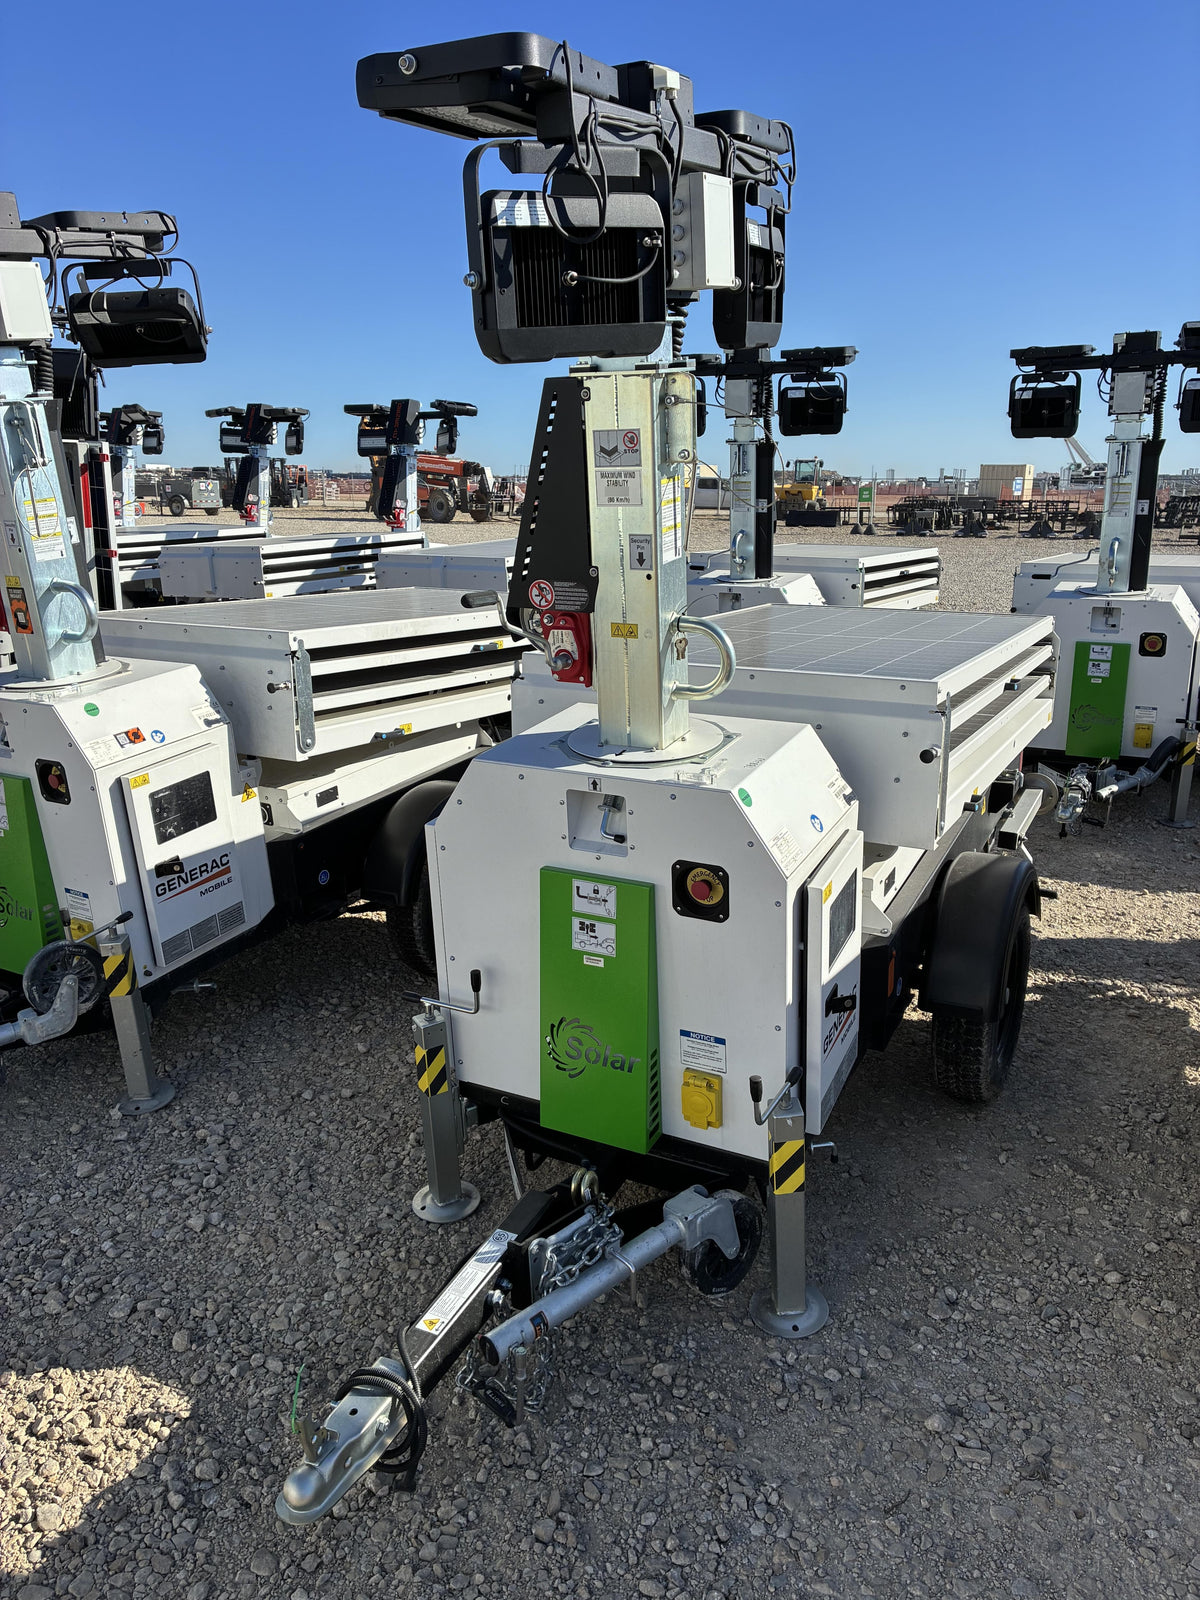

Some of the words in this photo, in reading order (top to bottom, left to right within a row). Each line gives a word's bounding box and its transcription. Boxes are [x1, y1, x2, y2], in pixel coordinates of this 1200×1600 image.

[600, 471, 622, 479] MAXIMUM
[623, 471, 636, 479] WIND
[155, 853, 231, 898] GENERAC
[690, 870, 721, 886] EMERGENCY
[200, 876, 233, 897] MOBILE
[690, 1032, 716, 1043] NOTICE
[565, 1035, 641, 1074] Solar
